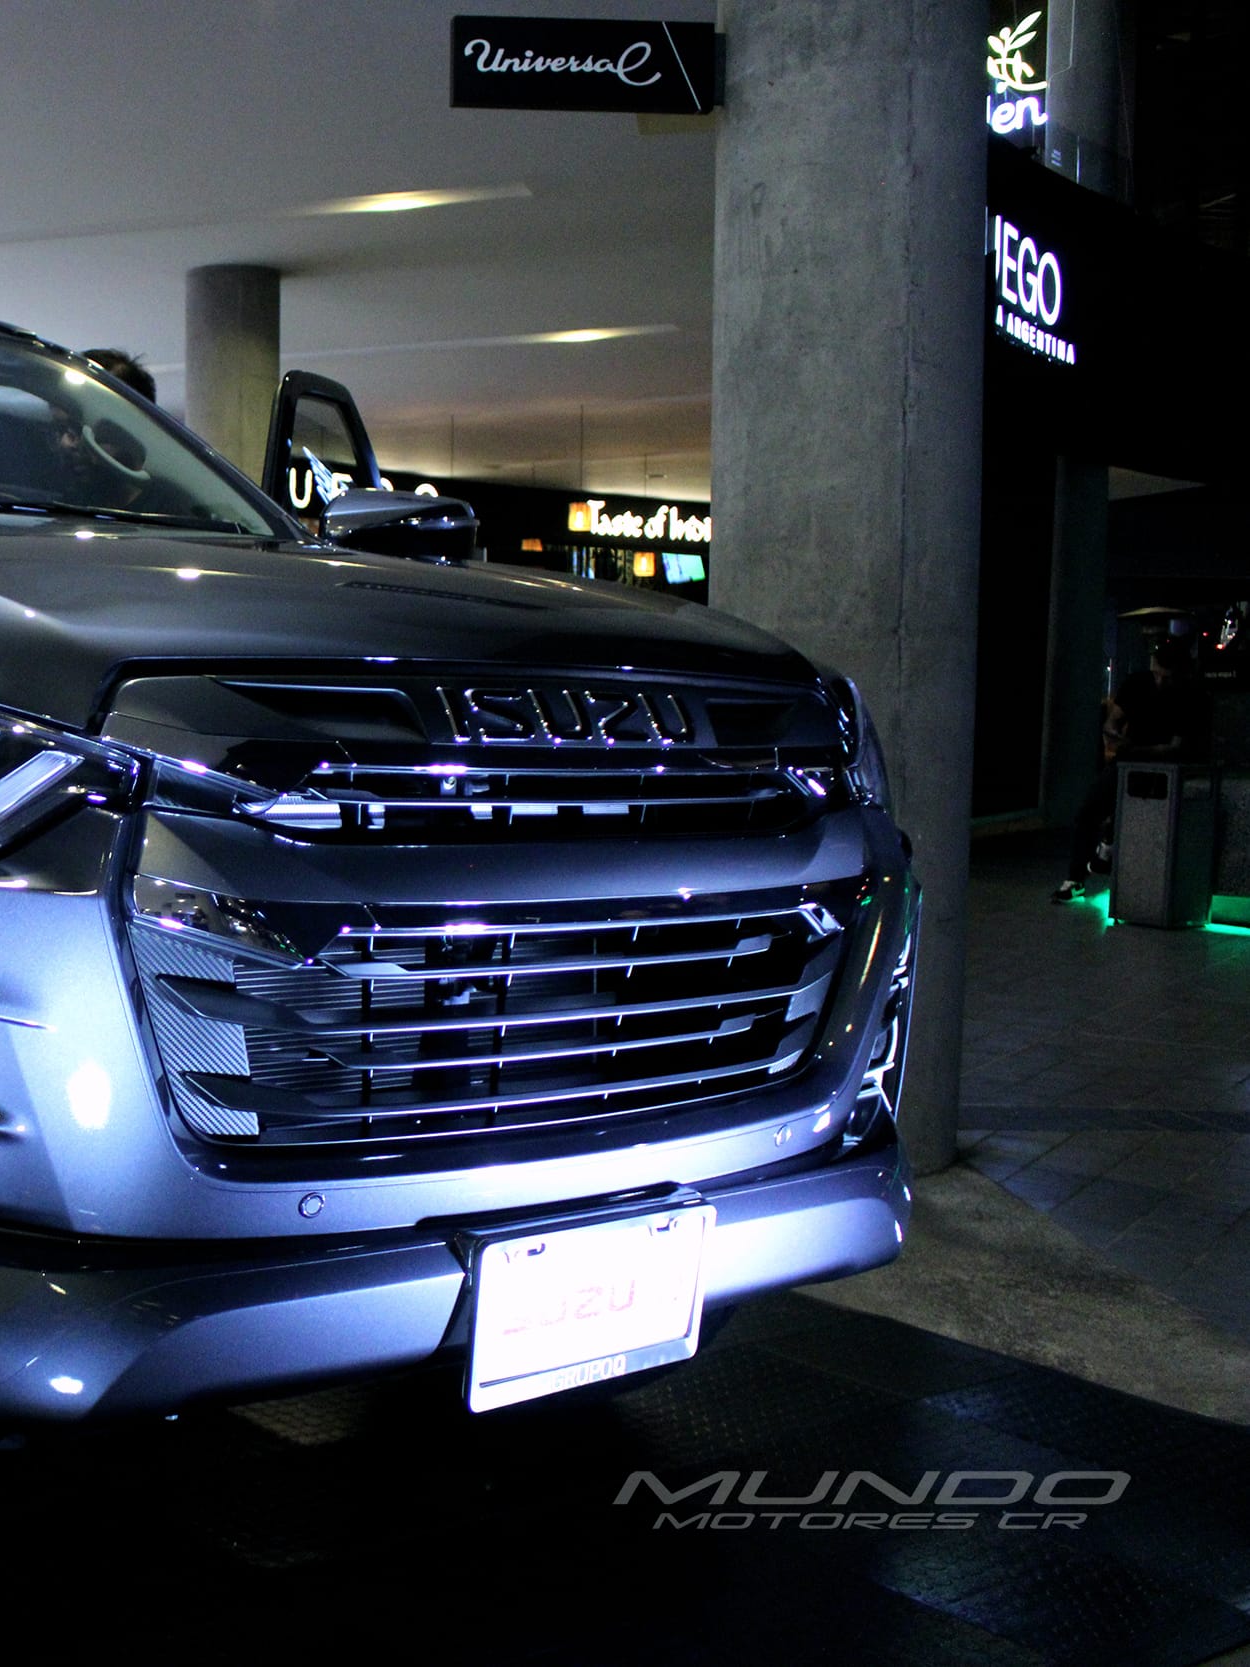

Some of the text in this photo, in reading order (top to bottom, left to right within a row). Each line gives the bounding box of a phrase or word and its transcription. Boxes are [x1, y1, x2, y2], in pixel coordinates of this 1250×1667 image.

[464, 39, 661, 86] Universal
[986, 94, 1048, 134] en
[1006, 312, 1075, 365] ARGENTINA
[587, 499, 643, 538] Taste
[643, 505, 669, 539] of
[435, 686, 692, 746] ISUZU
